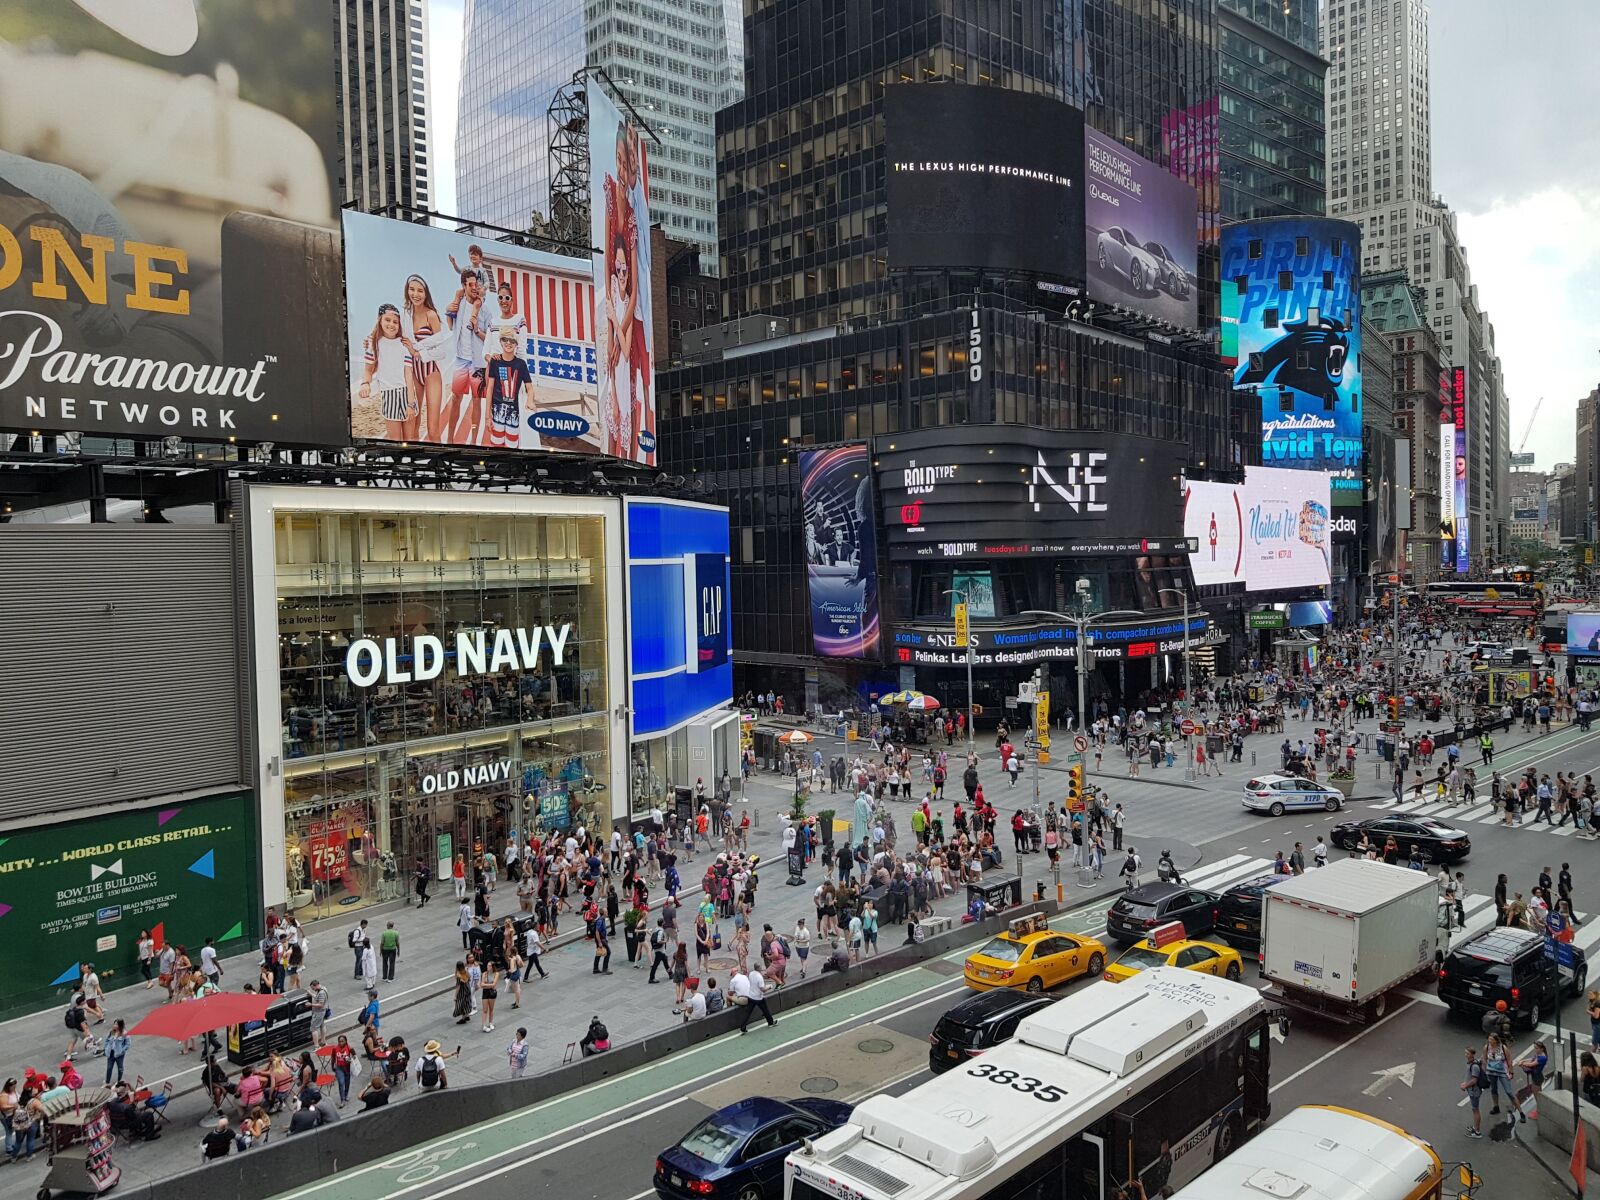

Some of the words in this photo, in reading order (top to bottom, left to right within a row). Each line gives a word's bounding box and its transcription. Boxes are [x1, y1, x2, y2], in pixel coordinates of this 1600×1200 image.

[1089, 143, 1099, 160] THE
[1100, 149, 1117, 169] LEXUS
[1118, 159, 1132, 178] HIGH
[894, 162, 914, 171] THE
[919, 162, 954, 171] LEXUS
[958, 163, 985, 172] HIGH
[989, 165, 1054, 183] PERFORMANCE
[1056, 175, 1071, 187] LINE
[1089, 158, 1130, 190] PERFORMANCE
[1131, 179, 1142, 196] LINE
[1098, 190, 1120, 207] LEXUS
[0, 310, 266, 402] Paramount
[970, 310, 982, 382] 1500
[1452, 369, 1464, 404] Locker
[26, 396, 236, 429] NETWORK
[535, 416, 555, 430] OLD
[556, 417, 583, 431] NAVY
[904, 466, 936, 494] BOLD
[935, 466, 954, 478] TYPE
[1249, 504, 1281, 545] Nailed
[1283, 509, 1298, 542] It!
[917, 546, 933, 555] watch
[943, 544, 963, 556] BOLD
[963, 543, 977, 552] TYPE
[1071, 543, 1114, 552] everywhere
[1116, 544, 1127, 552] you
[296, 615, 313, 624] love
[703, 585, 722, 637] GAP
[818, 601, 851, 614] American
[853, 602, 868, 613] Idol
[902, 634, 911, 642] on
[936, 634, 979, 647] NES
[993, 632, 1029, 645] Woman
[1039, 629, 1063, 639] dead
[1066, 629, 1075, 639] in
[1106, 627, 1148, 640] compactor
[1150, 626, 1156, 635] at
[1156, 625, 1173, 634] condo
[1206, 629, 1222, 641] HORA
[346, 634, 445, 687] OLD
[456, 623, 570, 676] NAVY
[915, 650, 949, 662] Pelinka:
[951, 652, 992, 664] Laers
[995, 650, 1033, 664] designed
[1038, 646, 1075, 657] combat
[1128, 642, 1158, 657] ESPN
[422, 771, 459, 795] OLD
[463, 761, 512, 787] NAVY
[1304, 794, 1320, 802] NYPD
[62, 843, 115, 861] WORLD
[117, 834, 161, 851] CLASS
[163, 825, 212, 842] RETAIL
[56, 886, 86, 901] BOW
[85, 882, 103, 894] TIE
[105, 871, 157, 891] BUILDING
[56, 898, 77, 908] TIMES
[77, 893, 104, 904] SQUARE
[121, 881, 158, 894] BROADWAY
[122, 902, 140, 911] BRAD
[140, 893, 178, 907] MENDELSON
[41, 918, 64, 929] DAVID
[72, 912, 95, 922] GREEN
[1145, 984, 1216, 1007] ELECTRIC
[1159, 981, 1216, 999] HYBRID
[1202, 1032, 1216, 1046] Hybrid
[1216, 1023, 1230, 1037] Electric
[1230, 1018, 1238, 1028] Bus
[967, 1064, 1069, 1103] 3835
[1189, 1125, 1211, 1149] TISSOT
